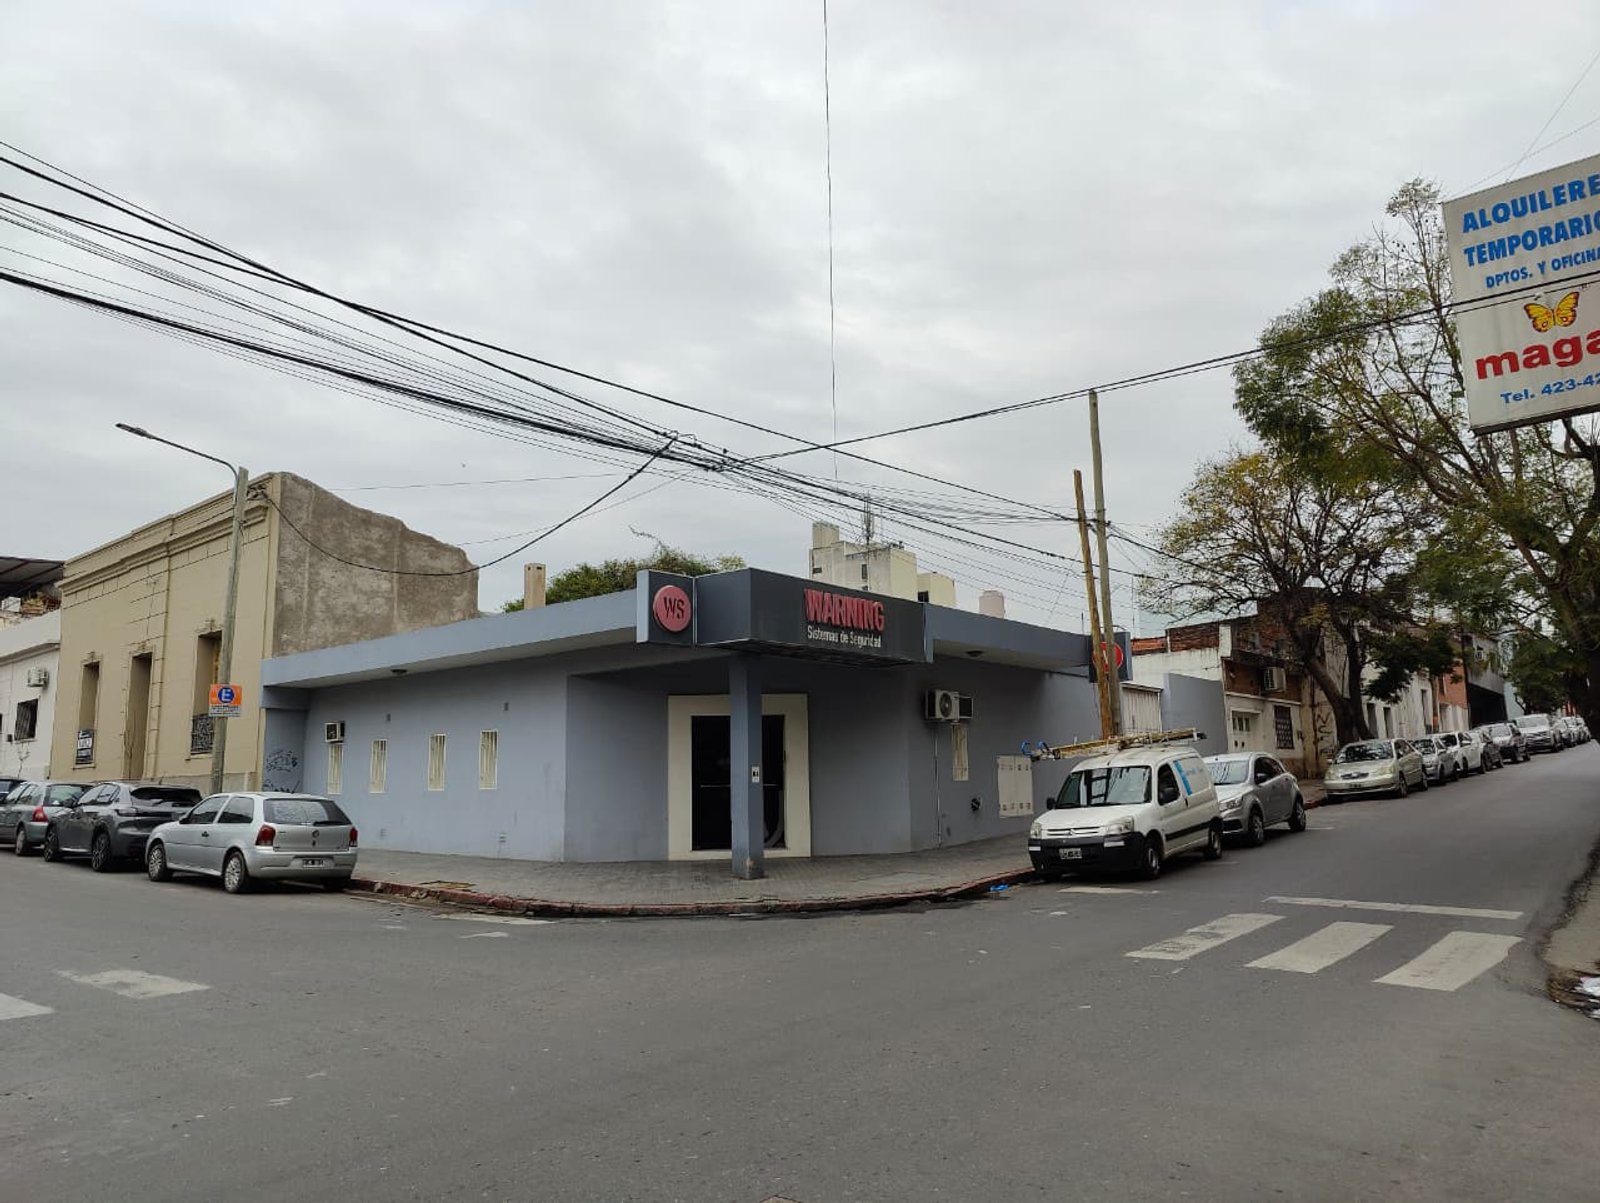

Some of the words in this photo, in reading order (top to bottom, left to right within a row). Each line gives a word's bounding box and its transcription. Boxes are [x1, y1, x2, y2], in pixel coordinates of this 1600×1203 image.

[1463, 174, 1600, 233] ALQUILERE
[1486, 266, 1533, 288] DPTOS.
[1537, 260, 1547, 275] Y
[1501, 389, 1535, 404] Tel.
[663, 596, 685, 619] WS
[804, 588, 885, 632] WARNING
[807, 624, 839, 643] Sistemas
[840, 631, 849, 644] de
[849, 630, 882, 649] Seguridad
